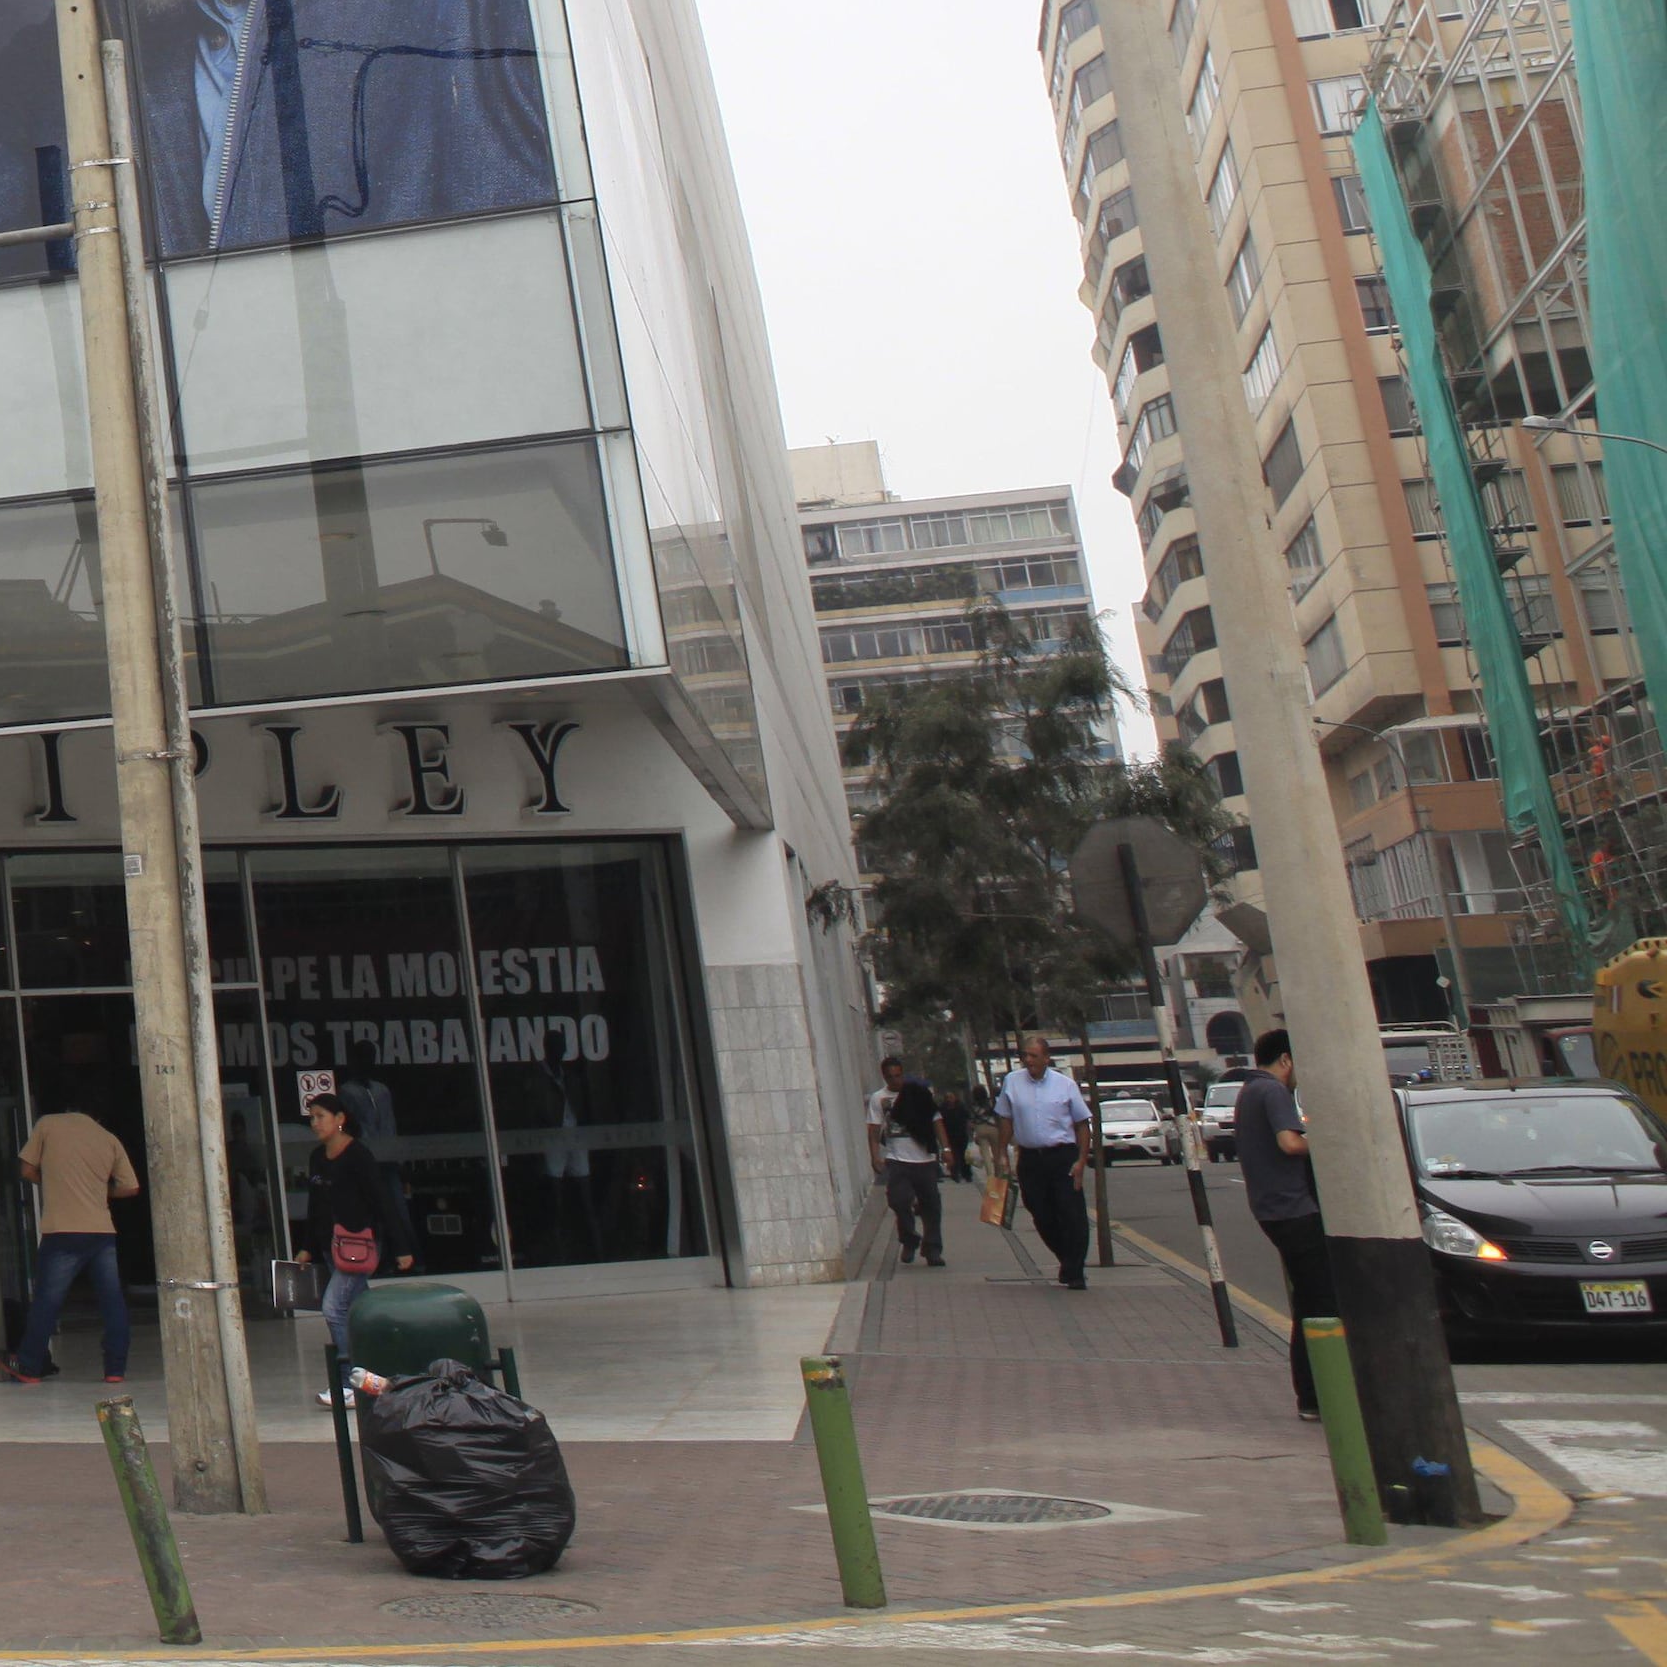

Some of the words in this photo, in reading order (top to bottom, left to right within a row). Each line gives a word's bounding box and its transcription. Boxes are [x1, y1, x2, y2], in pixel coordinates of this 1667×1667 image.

[327, 952, 381, 999] LA
[326, 1013, 611, 1066] TRABAANDO
[1586, 1290, 1647, 1309] D4T-116
